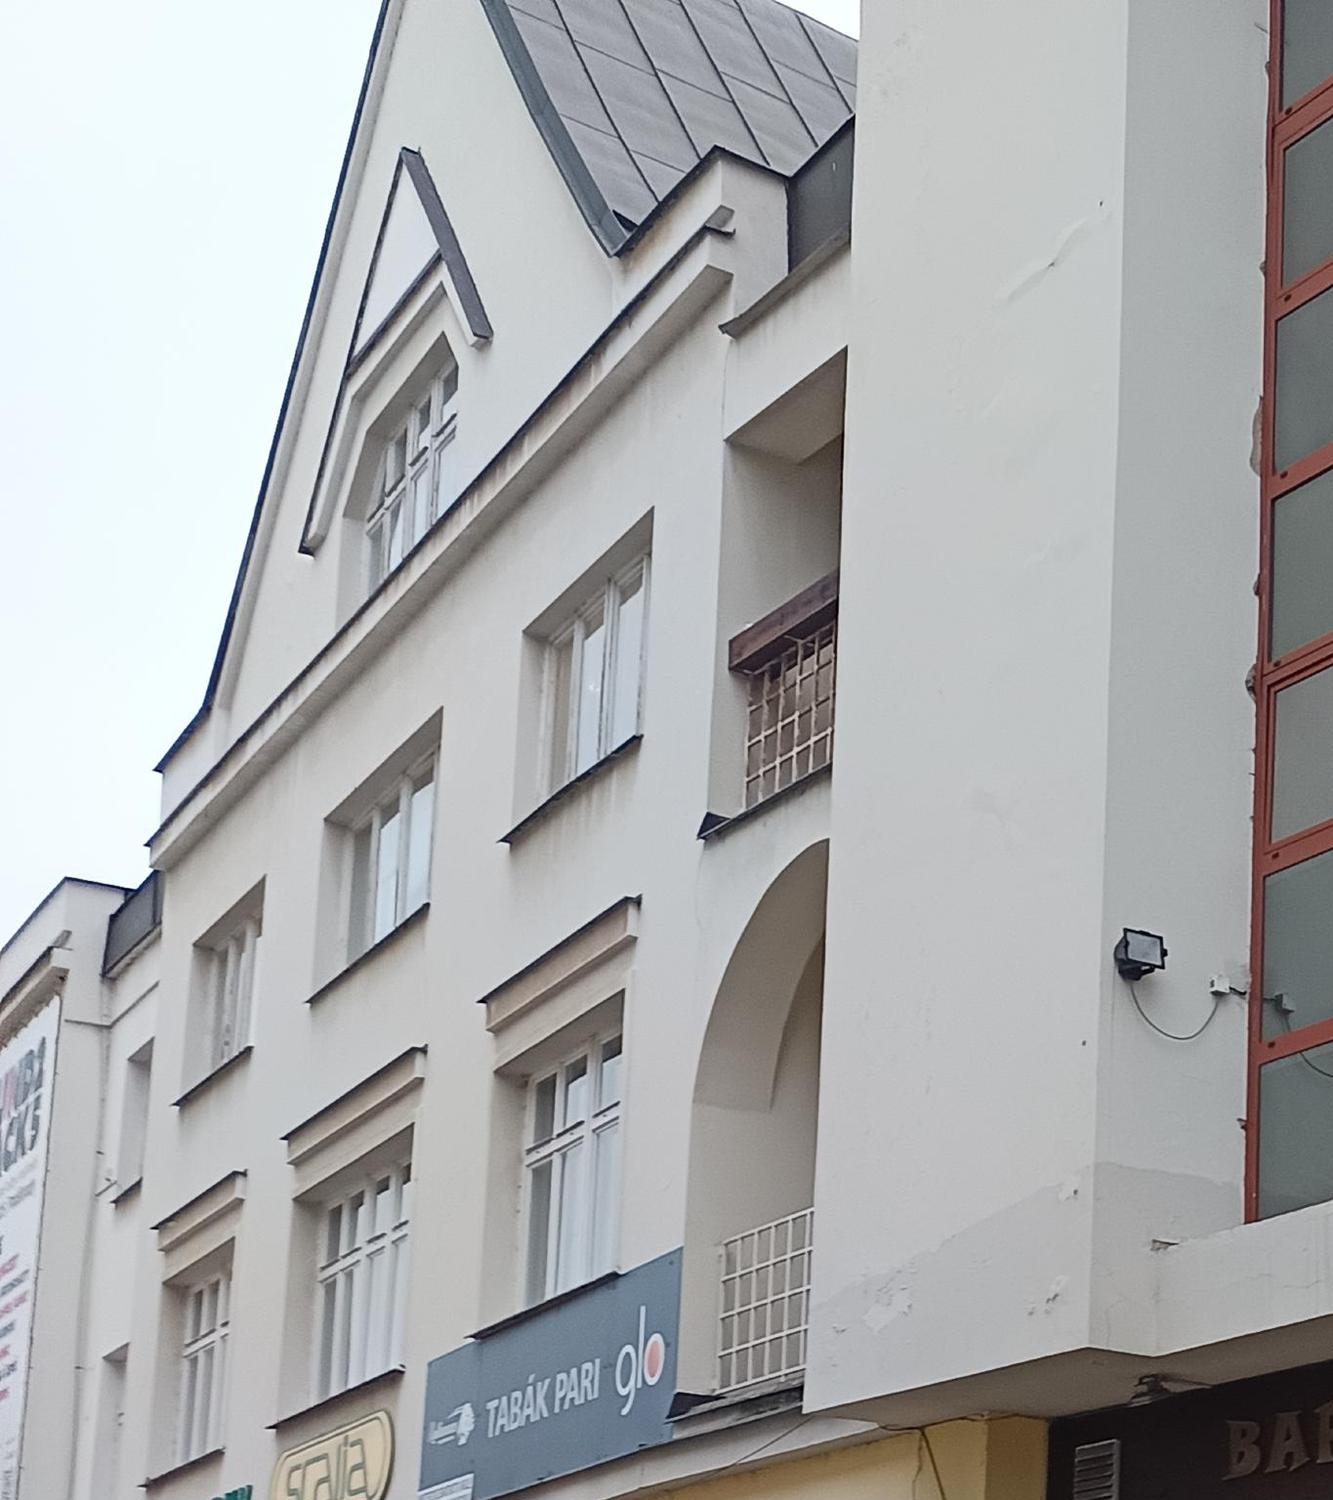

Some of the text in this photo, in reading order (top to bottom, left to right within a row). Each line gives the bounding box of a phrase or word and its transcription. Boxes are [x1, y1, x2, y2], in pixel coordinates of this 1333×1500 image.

[486, 1305, 665, 1438] TABÁK PARI glo
